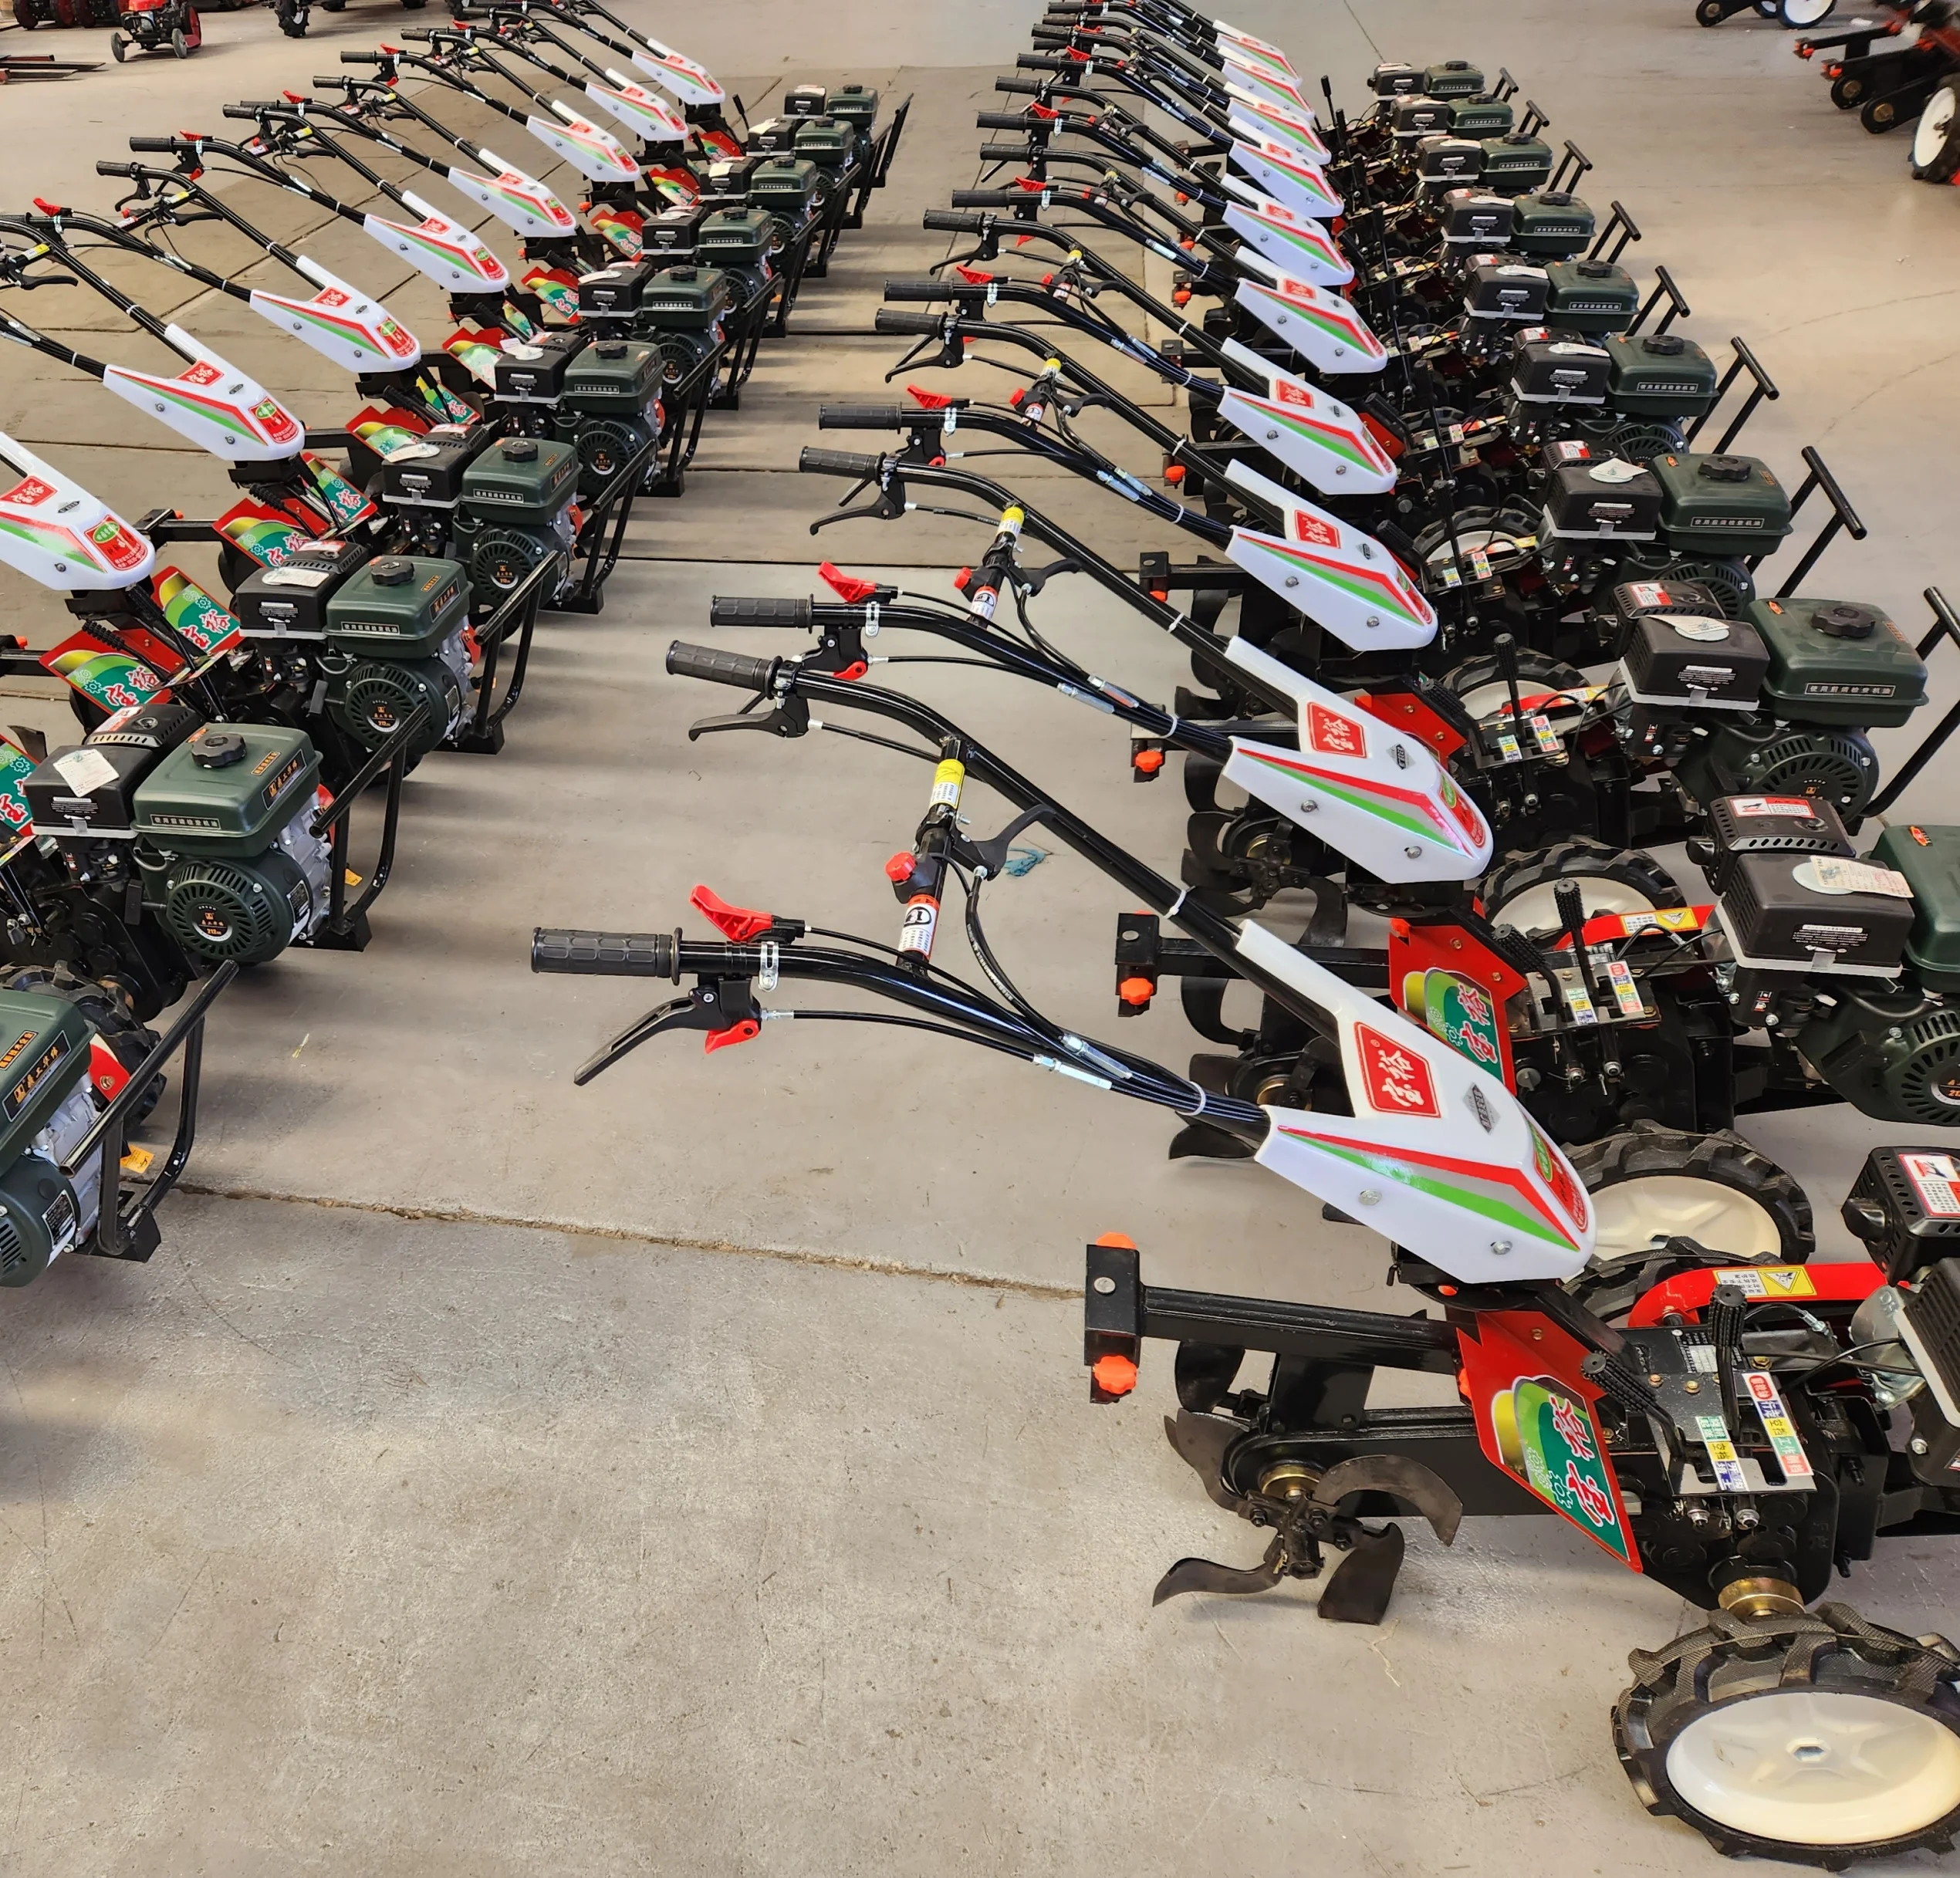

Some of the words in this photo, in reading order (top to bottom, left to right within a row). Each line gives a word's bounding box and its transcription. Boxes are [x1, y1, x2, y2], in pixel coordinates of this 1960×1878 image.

[1458, 982, 1498, 1063] 宝裕
[1378, 1048, 1424, 1106] 宝裕
[1550, 1393, 1614, 1527] 宝裕
[1776, 1437, 1798, 1455] 工作
